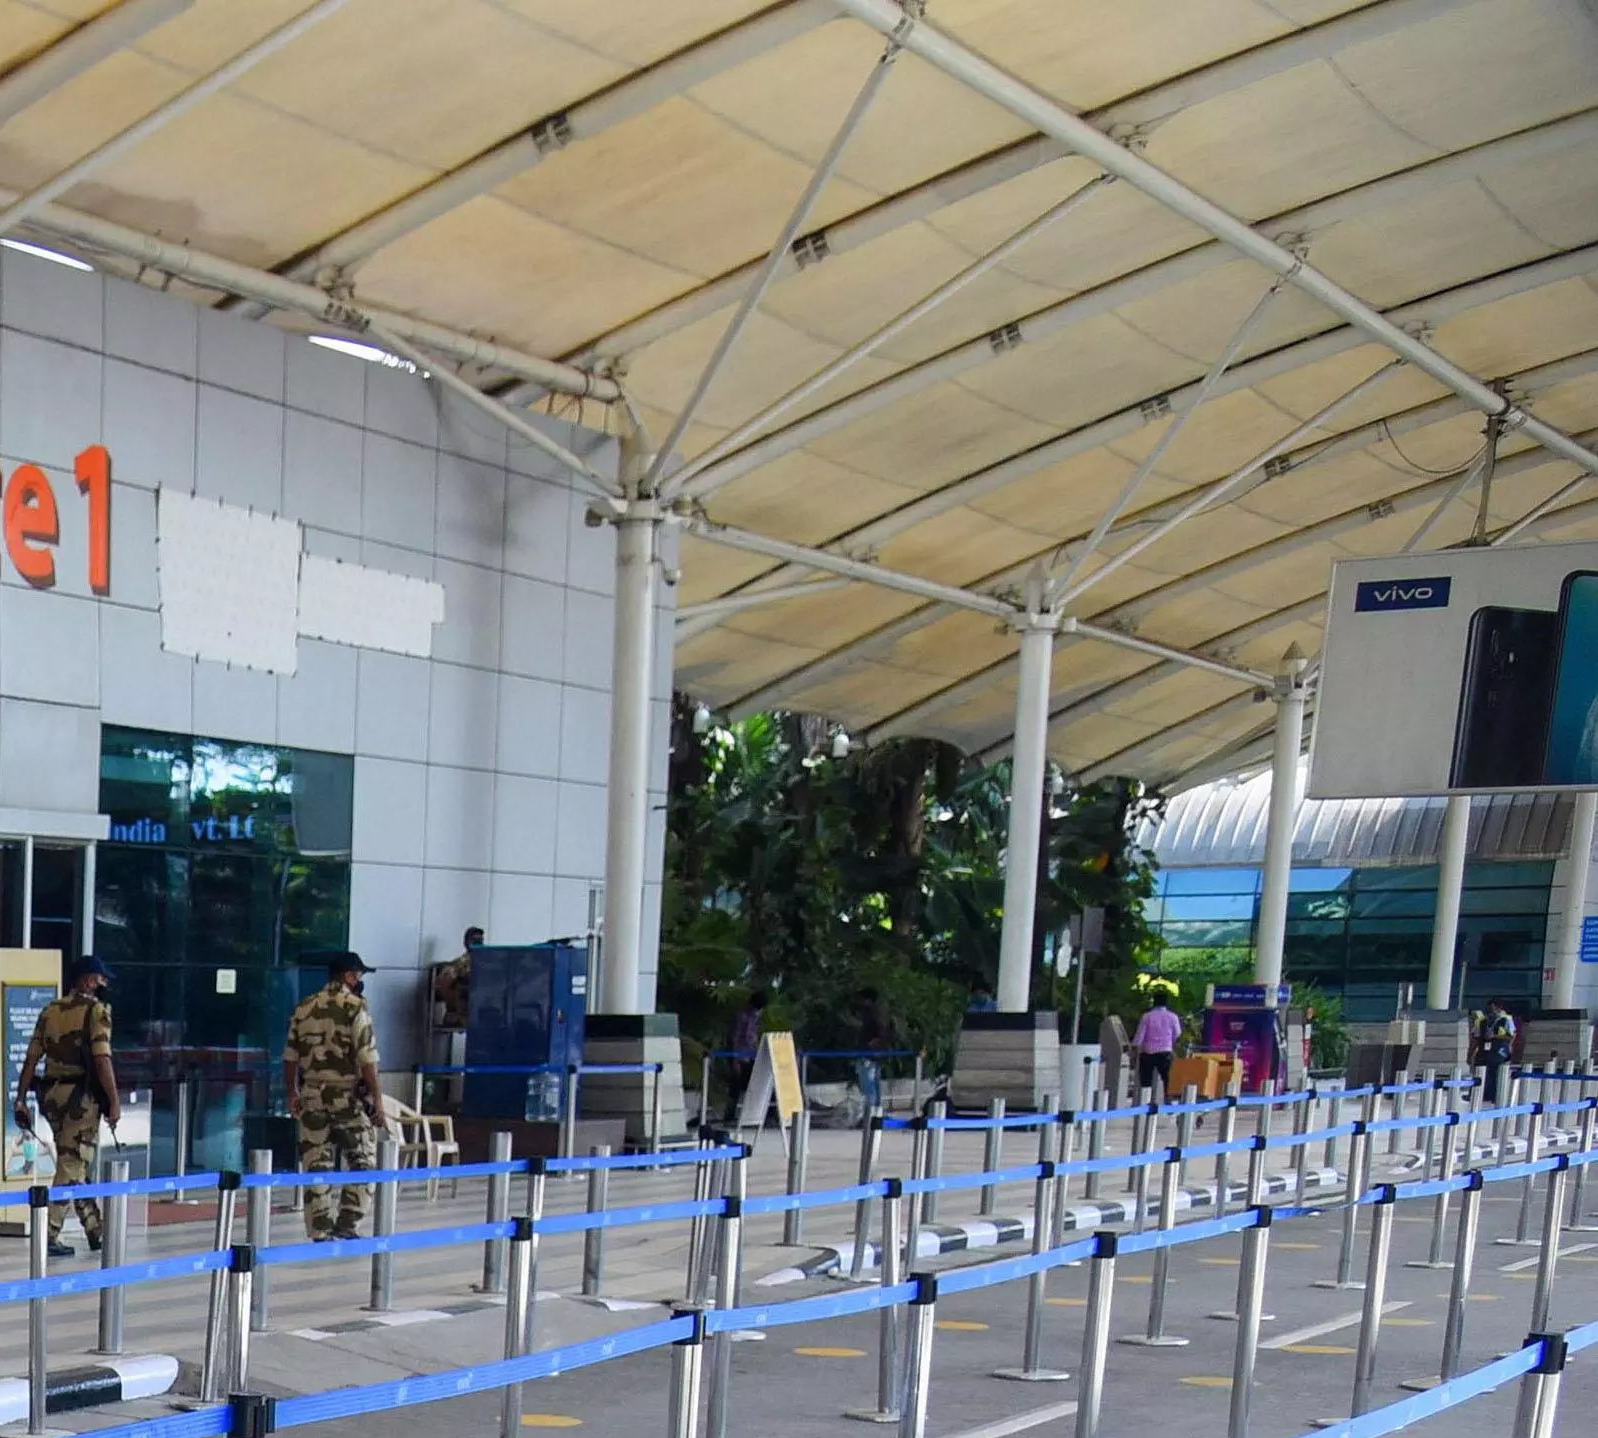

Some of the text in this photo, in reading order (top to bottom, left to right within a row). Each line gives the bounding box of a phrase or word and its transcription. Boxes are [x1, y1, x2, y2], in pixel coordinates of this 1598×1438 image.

[74, 443, 113, 597] 1
[1374, 585, 1433, 602] vivo
[111, 816, 167, 843] ndia
